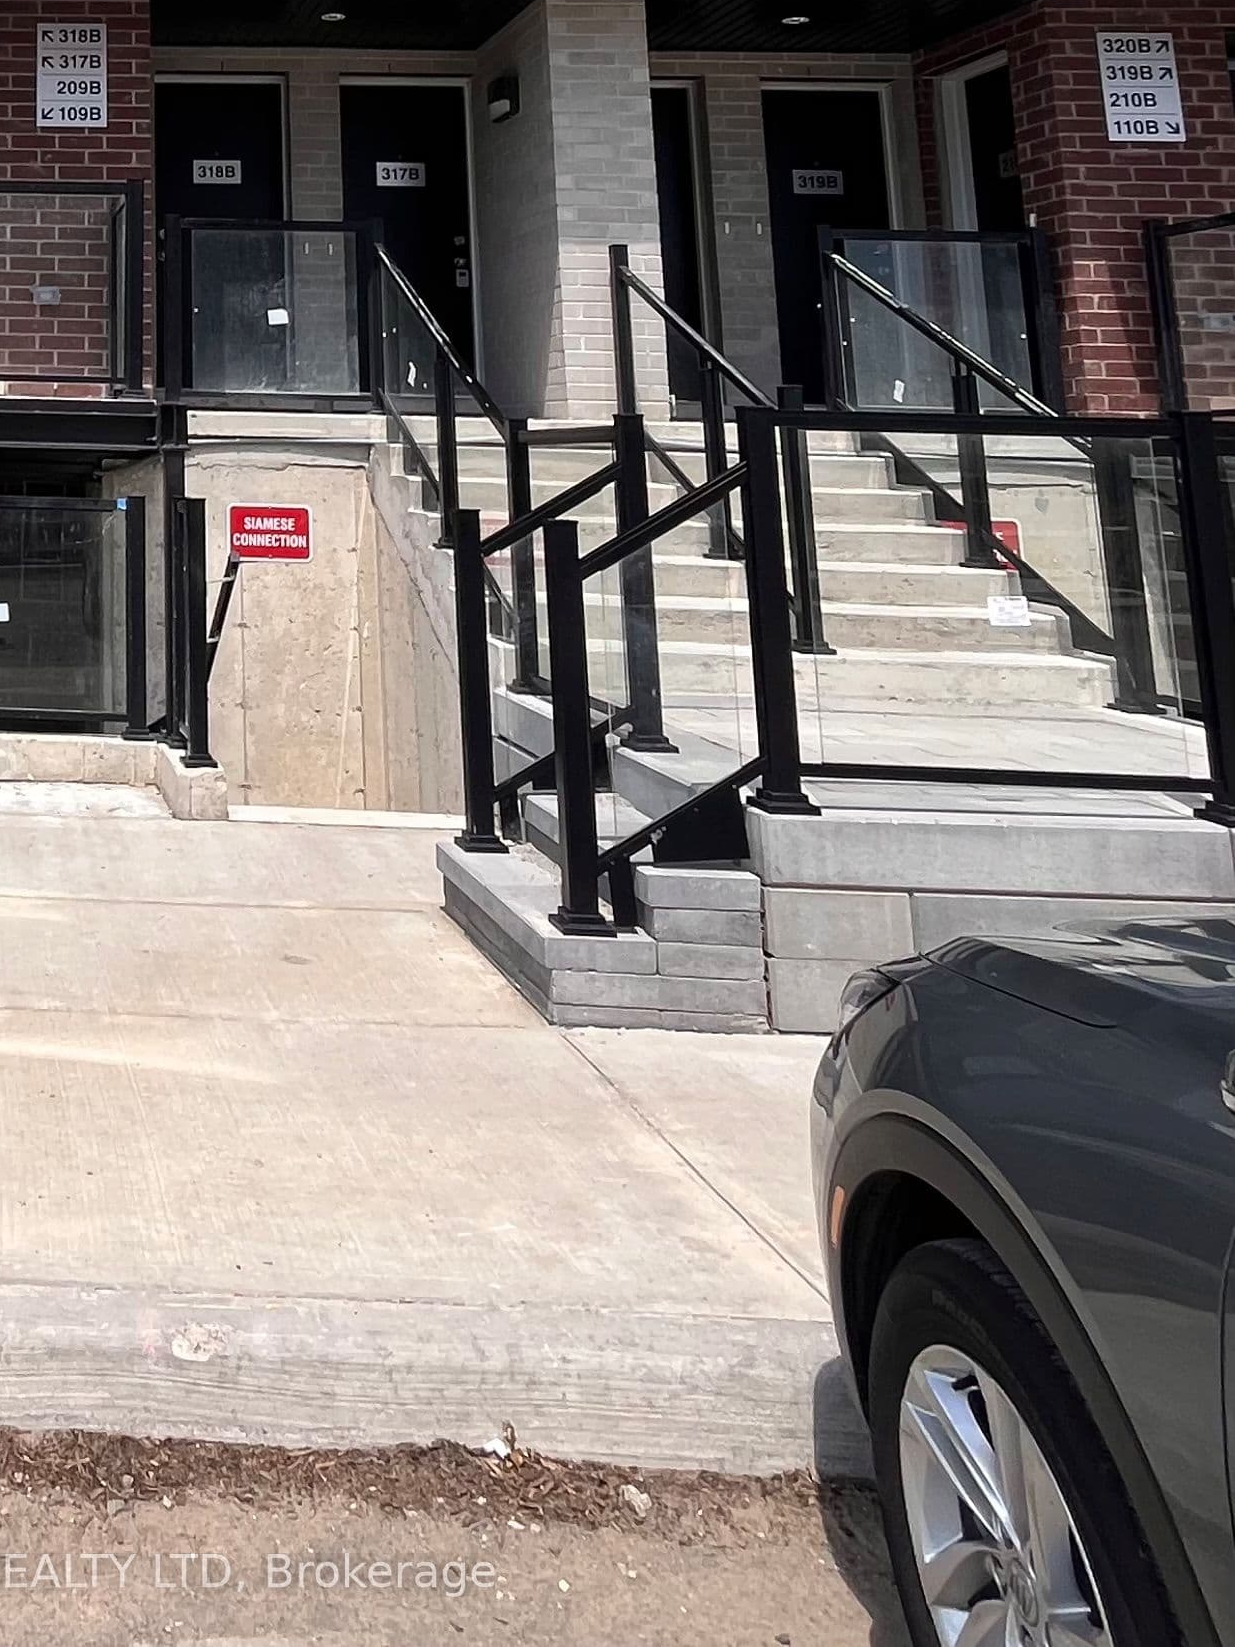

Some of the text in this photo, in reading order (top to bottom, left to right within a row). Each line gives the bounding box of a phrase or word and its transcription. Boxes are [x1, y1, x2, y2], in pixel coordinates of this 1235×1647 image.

[58, 29, 101, 43] 318B
[1103, 38, 1151, 53] 320B
[58, 54, 101, 68] 317B
[1106, 65, 1153, 80] 319B
[57, 81, 101, 95] 209B
[1109, 92, 1157, 107] 210B
[58, 106, 101, 120] 109B
[1113, 120, 1159, 135] 110B
[197, 165, 236, 178] 318B
[381, 167, 420, 181] 317B
[797, 175, 838, 189] 319B
[243, 516, 296, 531] SIAMESE
[232, 533, 307, 548] CONNECTION
